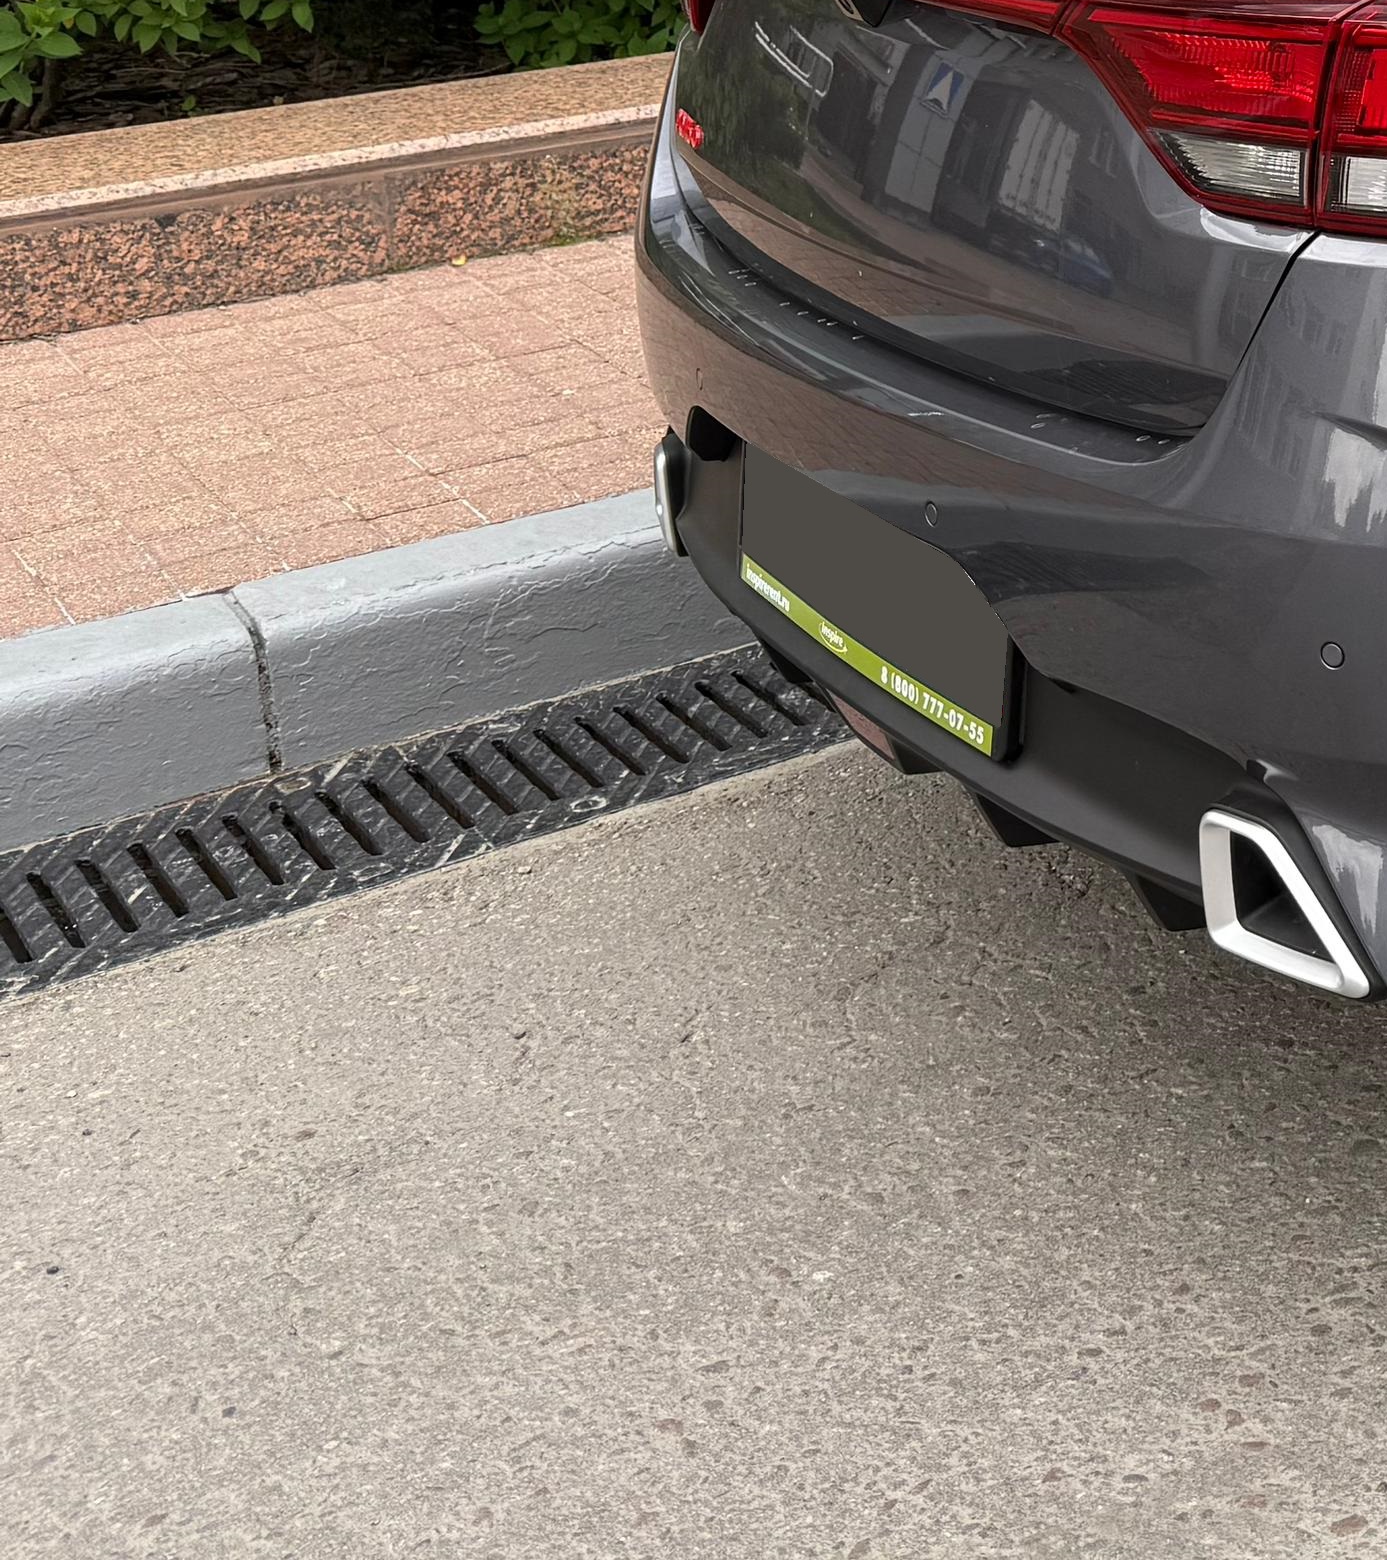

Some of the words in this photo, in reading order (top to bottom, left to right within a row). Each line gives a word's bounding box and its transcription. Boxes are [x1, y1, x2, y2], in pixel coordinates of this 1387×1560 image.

[746, 564, 790, 613] inspirerent.ru
[880, 666, 888, 685] 8
[890, 670, 919, 705] (800)
[923, 692, 984, 745] 777-07-55
